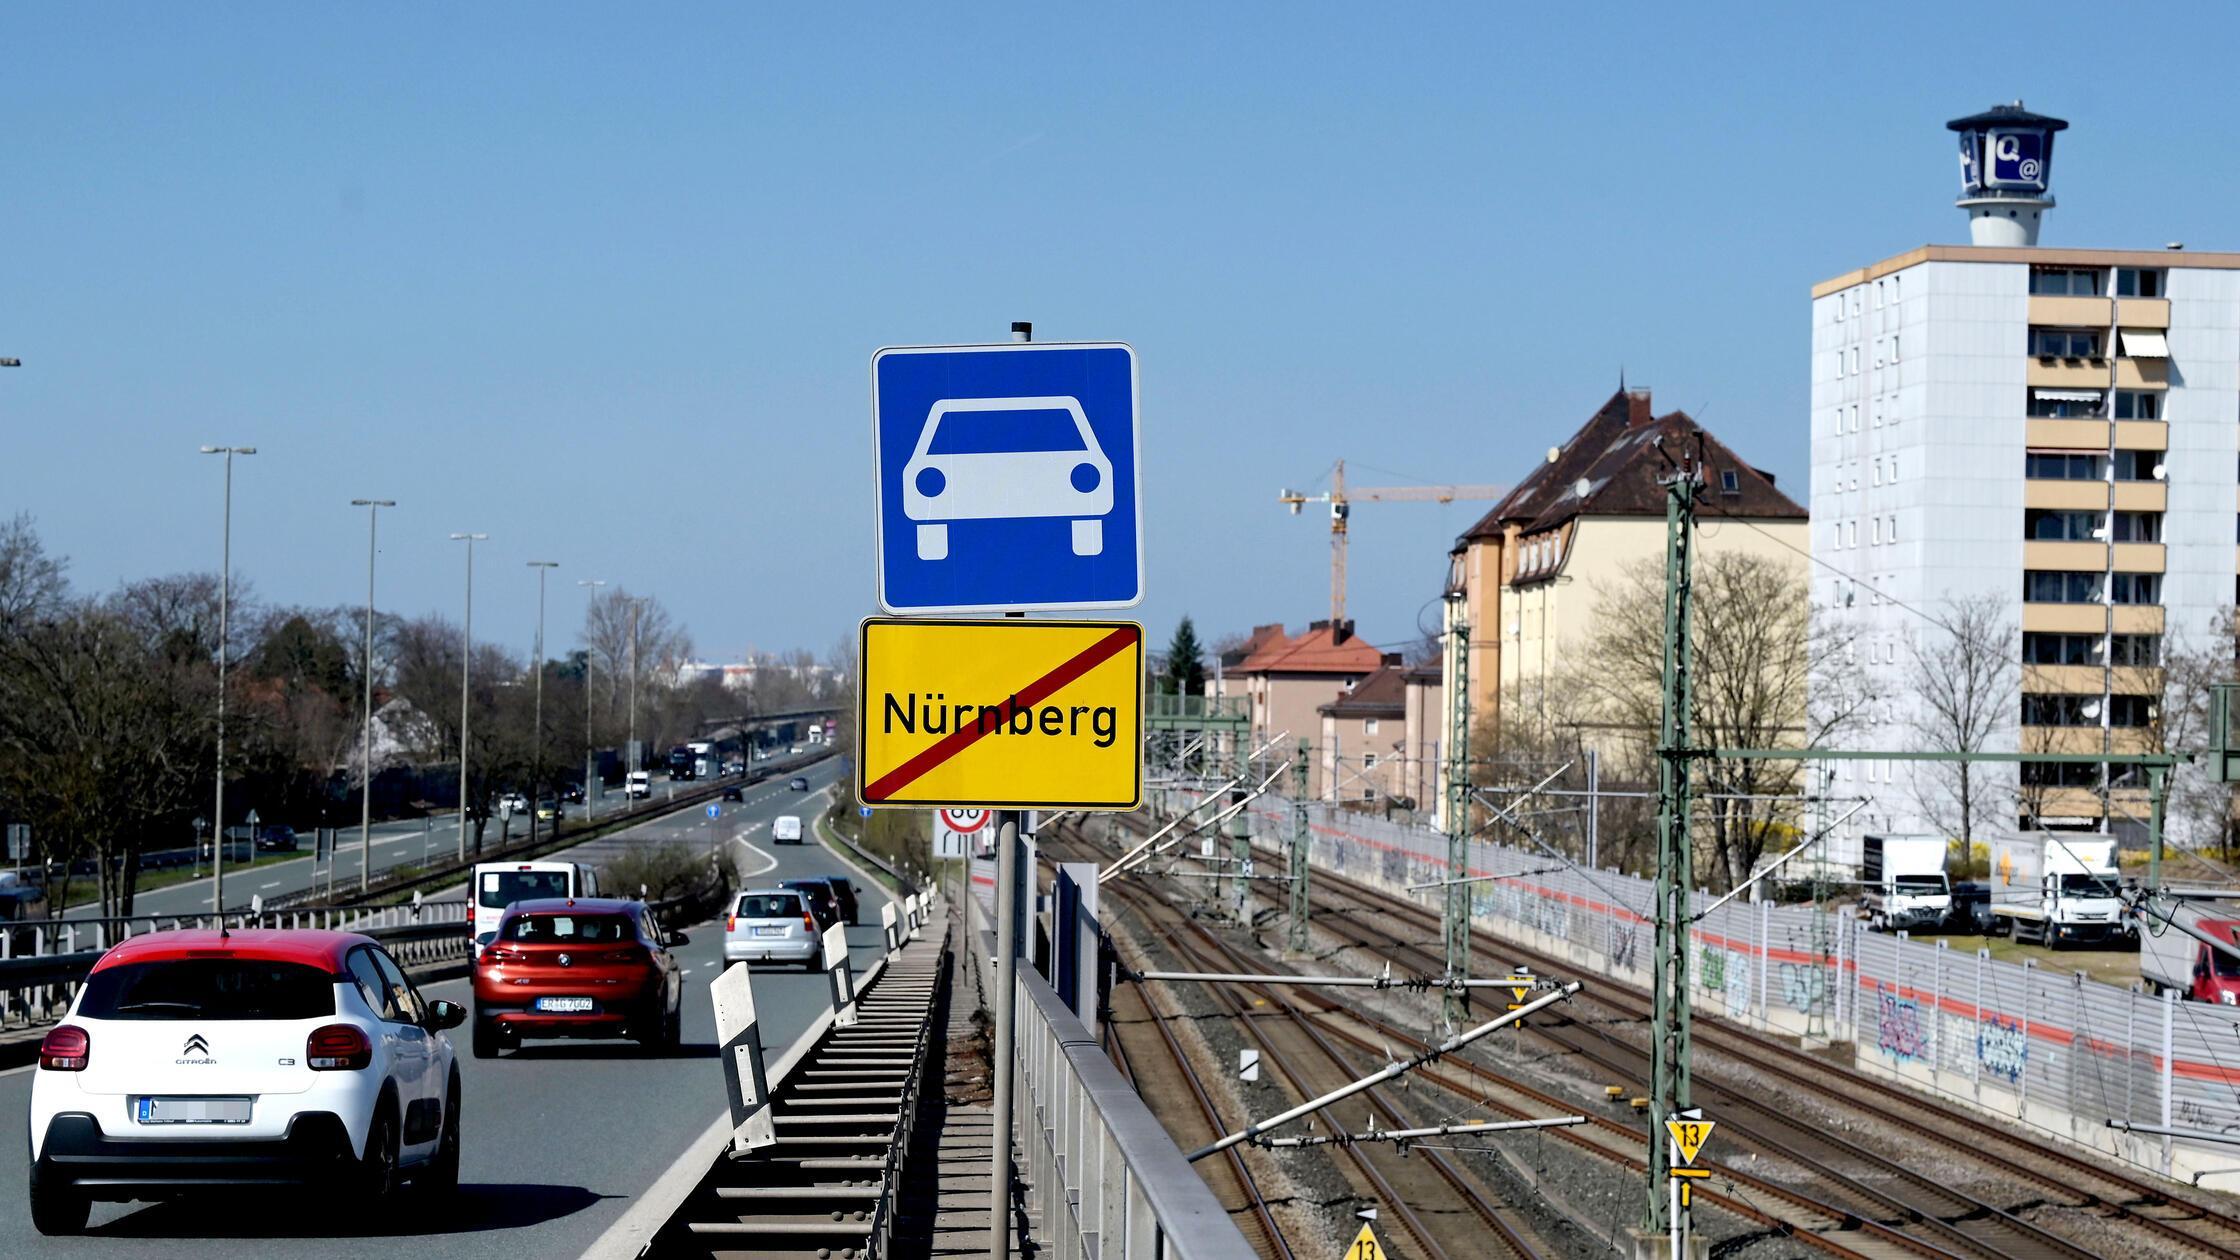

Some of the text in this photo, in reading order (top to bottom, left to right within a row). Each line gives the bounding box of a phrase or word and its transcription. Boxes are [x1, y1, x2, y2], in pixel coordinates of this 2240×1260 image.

[1996, 135, 2020, 162] Q
[2018, 158, 2039, 181] @
[884, 692, 1117, 748] Nürnberg
[278, 1058, 296, 1066] C3
[1681, 1124, 1699, 1147] 13
[1356, 1240, 1375, 1260] 13
